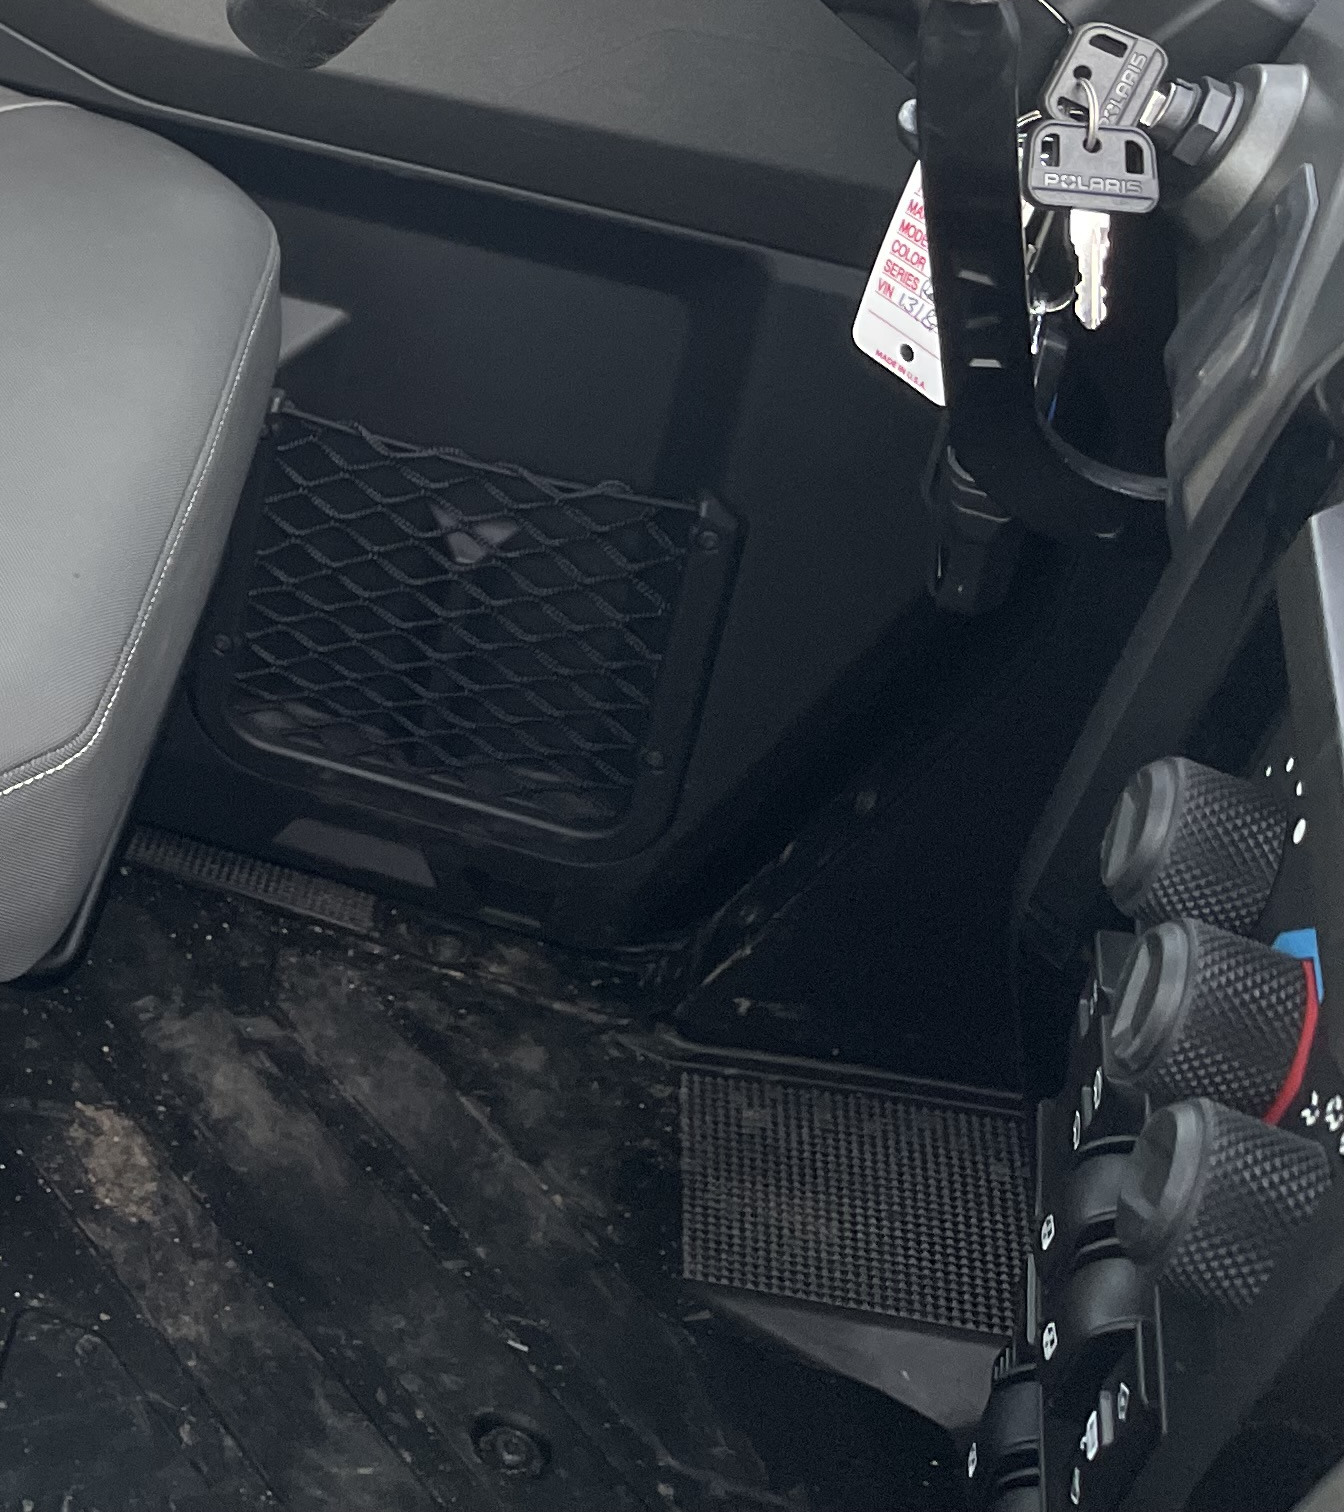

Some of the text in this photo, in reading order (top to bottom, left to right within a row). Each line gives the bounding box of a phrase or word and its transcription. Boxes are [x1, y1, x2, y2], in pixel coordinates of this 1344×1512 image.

[1044, 172, 1143, 194] POLARIS
[907, 198, 925, 219] MA
[891, 239, 926, 271] COLOR
[883, 259, 920, 291] SERIES
[877, 277, 895, 299] VIN
[875, 348, 897, 369] MADE
[897, 364, 907, 376] IN
